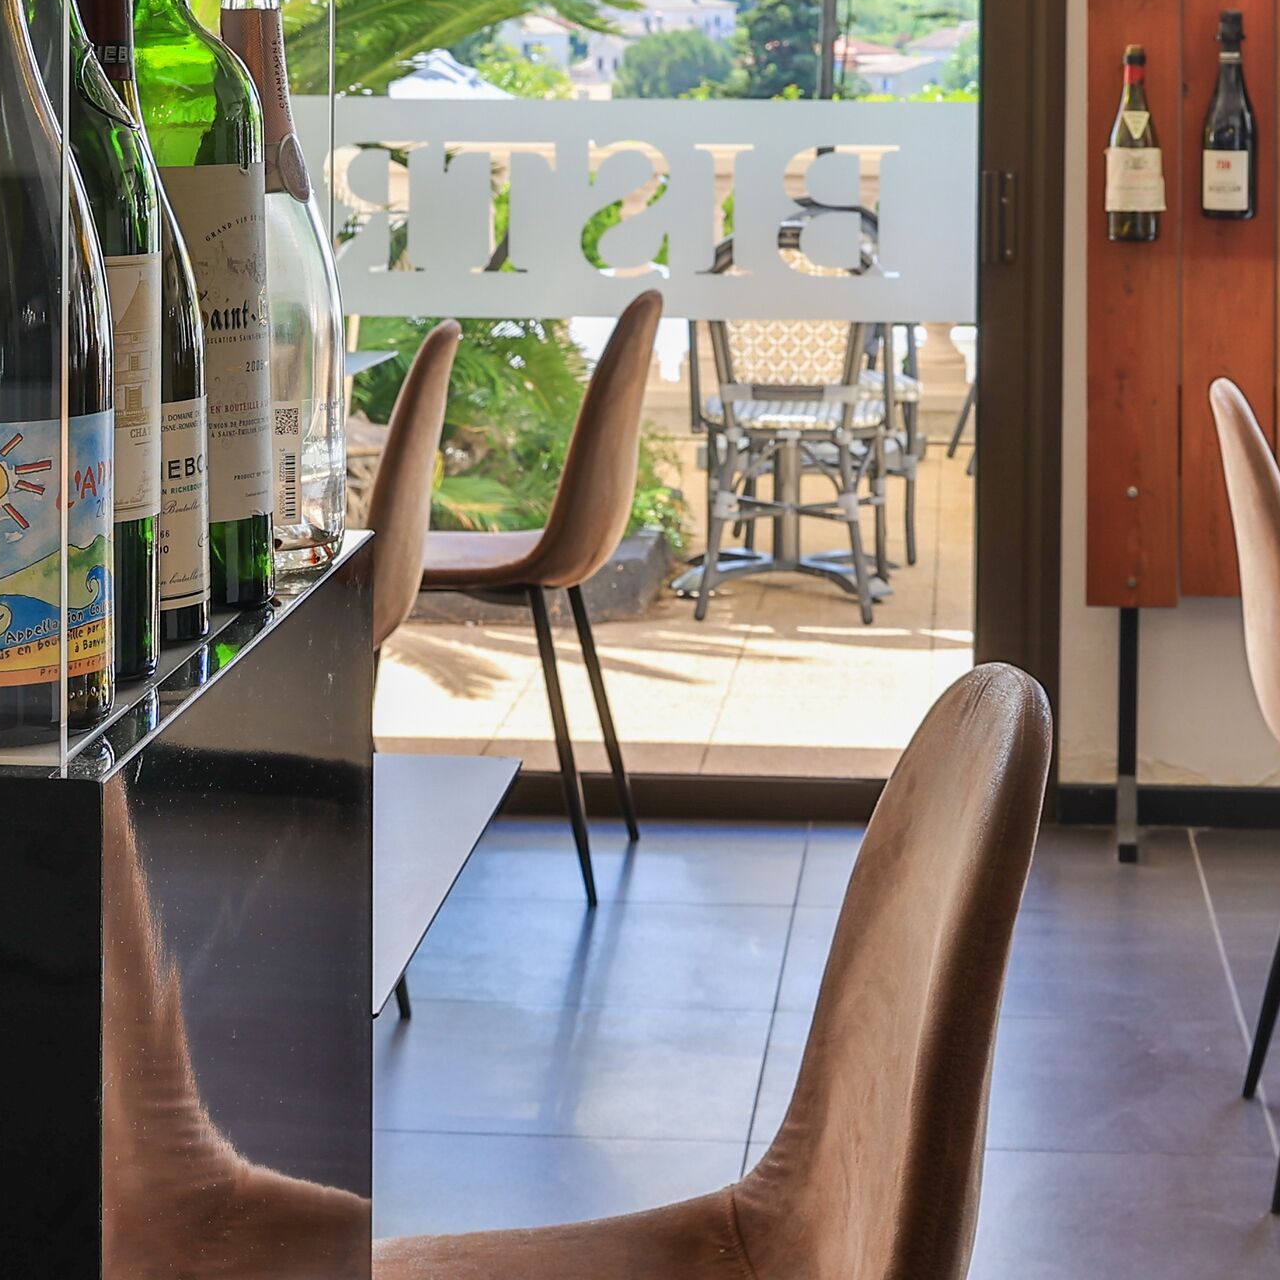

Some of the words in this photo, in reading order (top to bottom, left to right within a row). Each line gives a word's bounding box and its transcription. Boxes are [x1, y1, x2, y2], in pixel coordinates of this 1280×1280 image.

[272, 39, 285, 109] CHAMPAGNE
[205, 222, 232, 242] GRAND
[167, 411, 193, 422] DOMAINE
[210, 405, 221, 414] EN
[224, 400, 259, 413] BOUTEILLE
[6, 610, 84, 645] Appellaion
[17, 644, 31, 656] en
[37, 628, 84, 651] boueille
